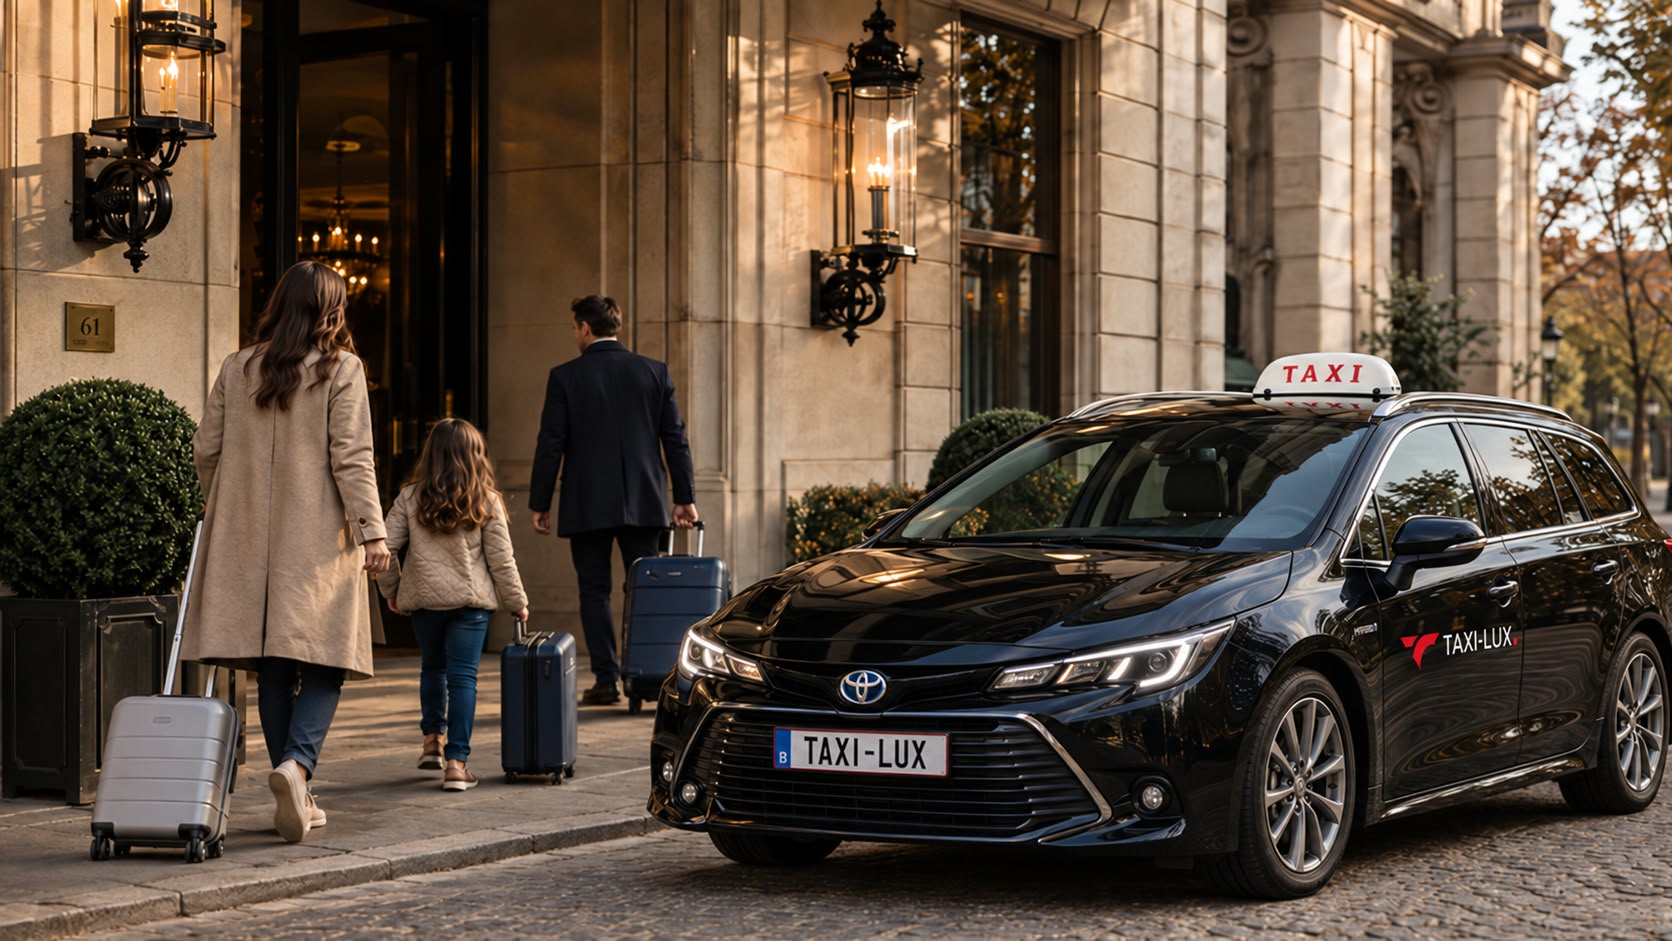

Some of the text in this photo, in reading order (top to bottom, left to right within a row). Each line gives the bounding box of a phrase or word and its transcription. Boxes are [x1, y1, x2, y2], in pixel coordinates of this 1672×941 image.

[80, 316, 99, 337] 61
[1282, 364, 1363, 384] TAXI
[779, 751, 788, 764] B
[804, 736, 927, 770] TAXI-LUX
